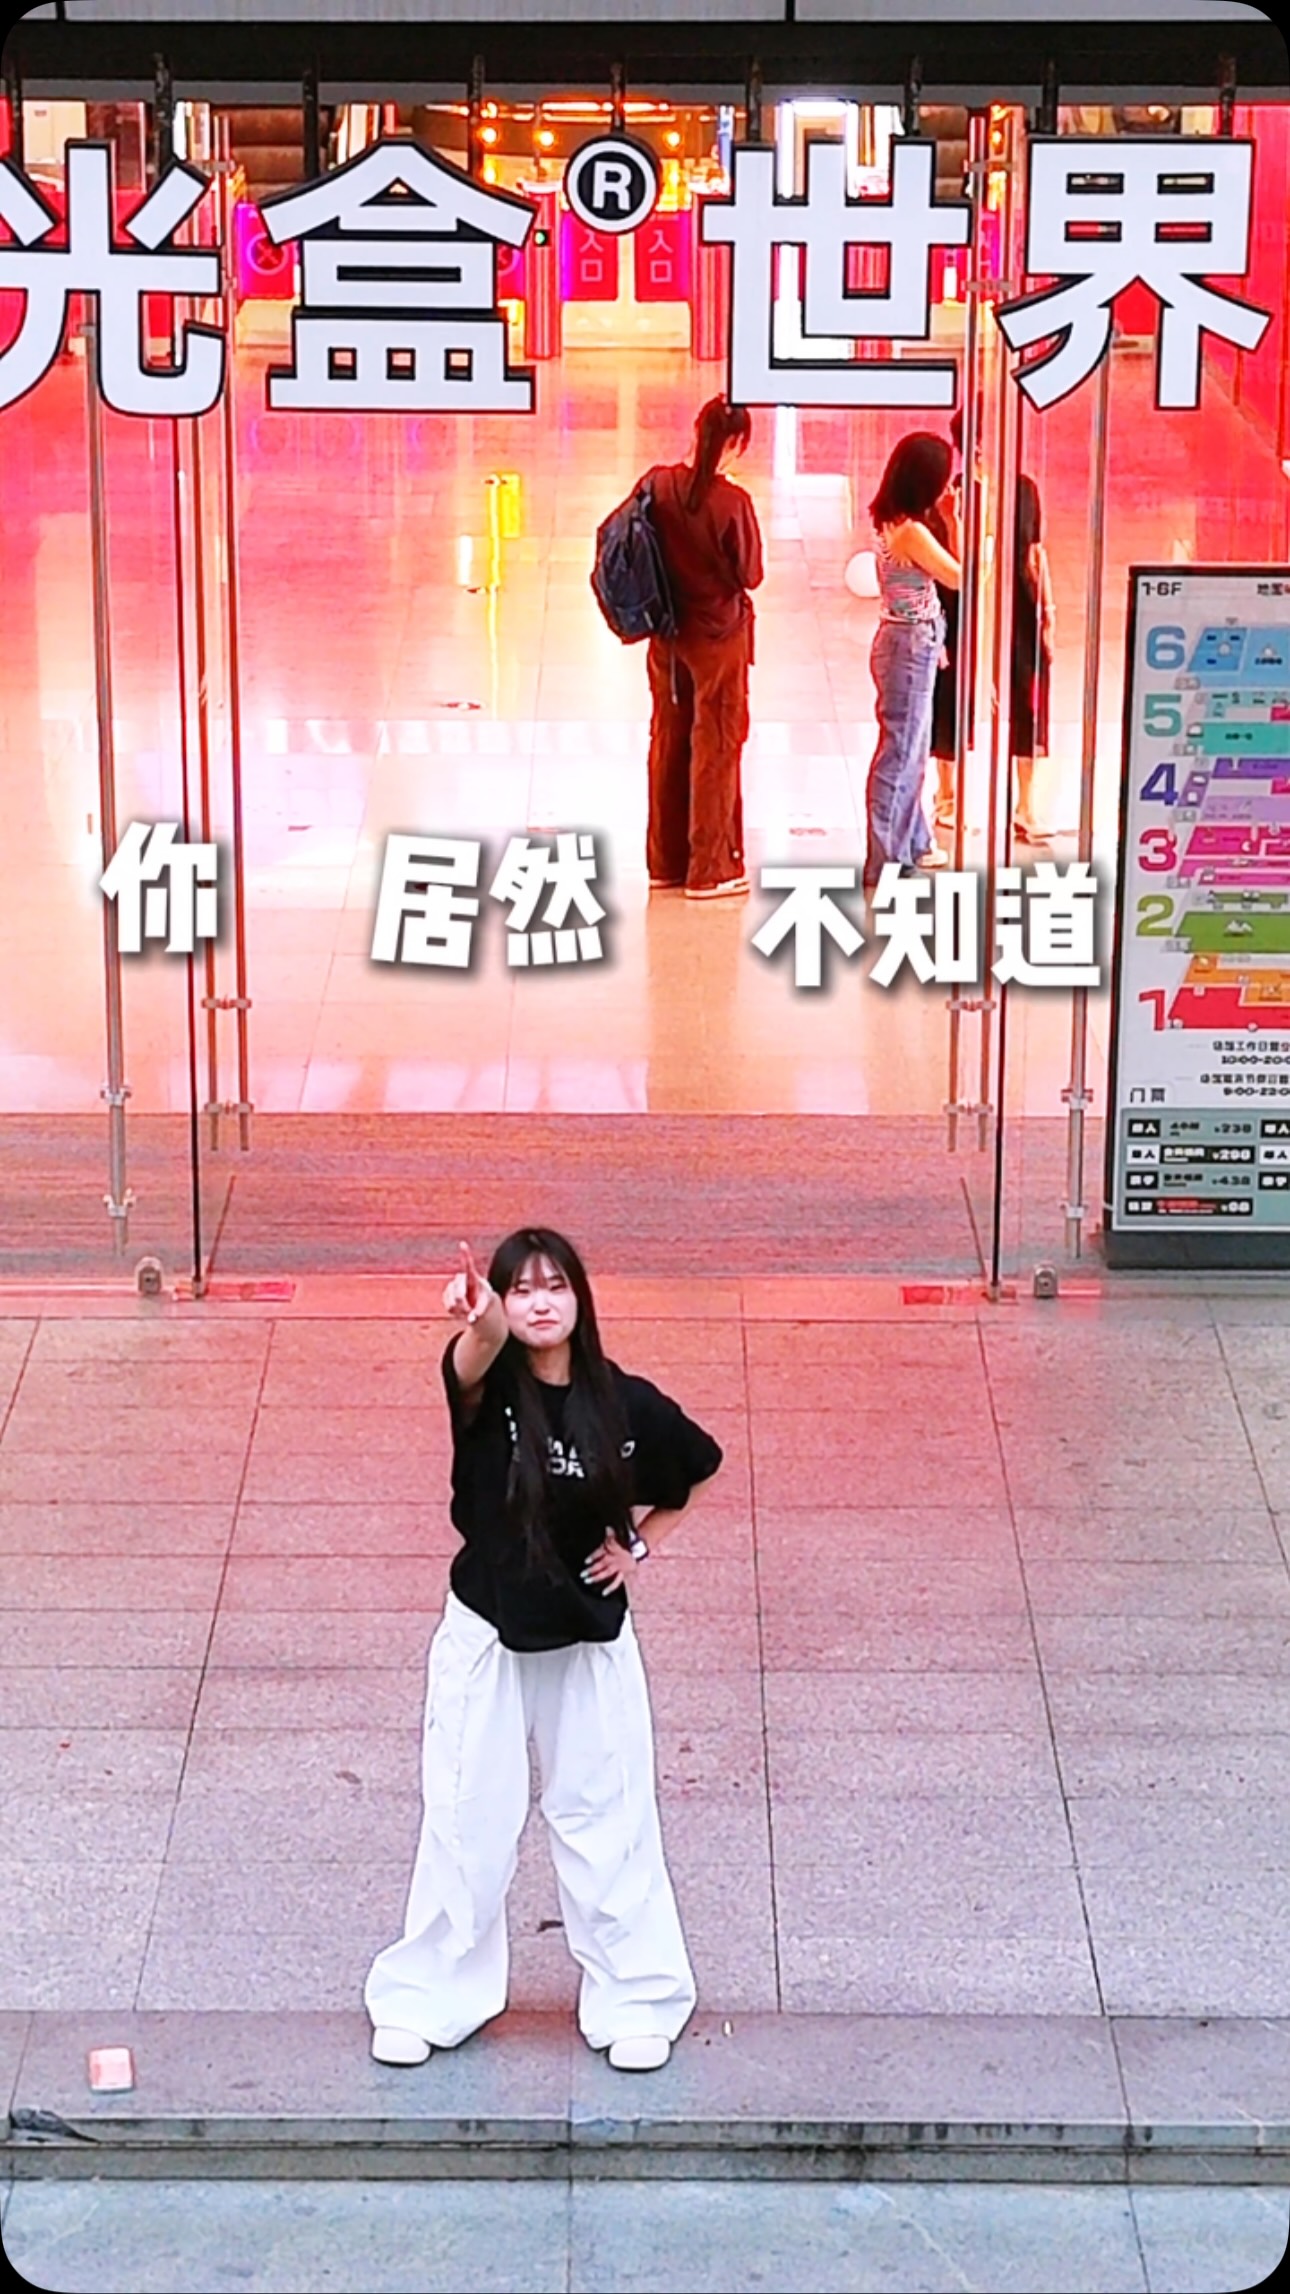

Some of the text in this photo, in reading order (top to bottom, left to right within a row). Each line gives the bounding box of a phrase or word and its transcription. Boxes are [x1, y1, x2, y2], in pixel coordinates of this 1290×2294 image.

[649, 230, 673, 283] 入口
[1146, 626, 1186, 670] 6
[1143, 694, 1182, 737] 5
[1139, 763, 1178, 806] 4
[1138, 829, 1177, 872] 3
[1136, 894, 1174, 936] 2
[1139, 990, 1165, 1031] 1
